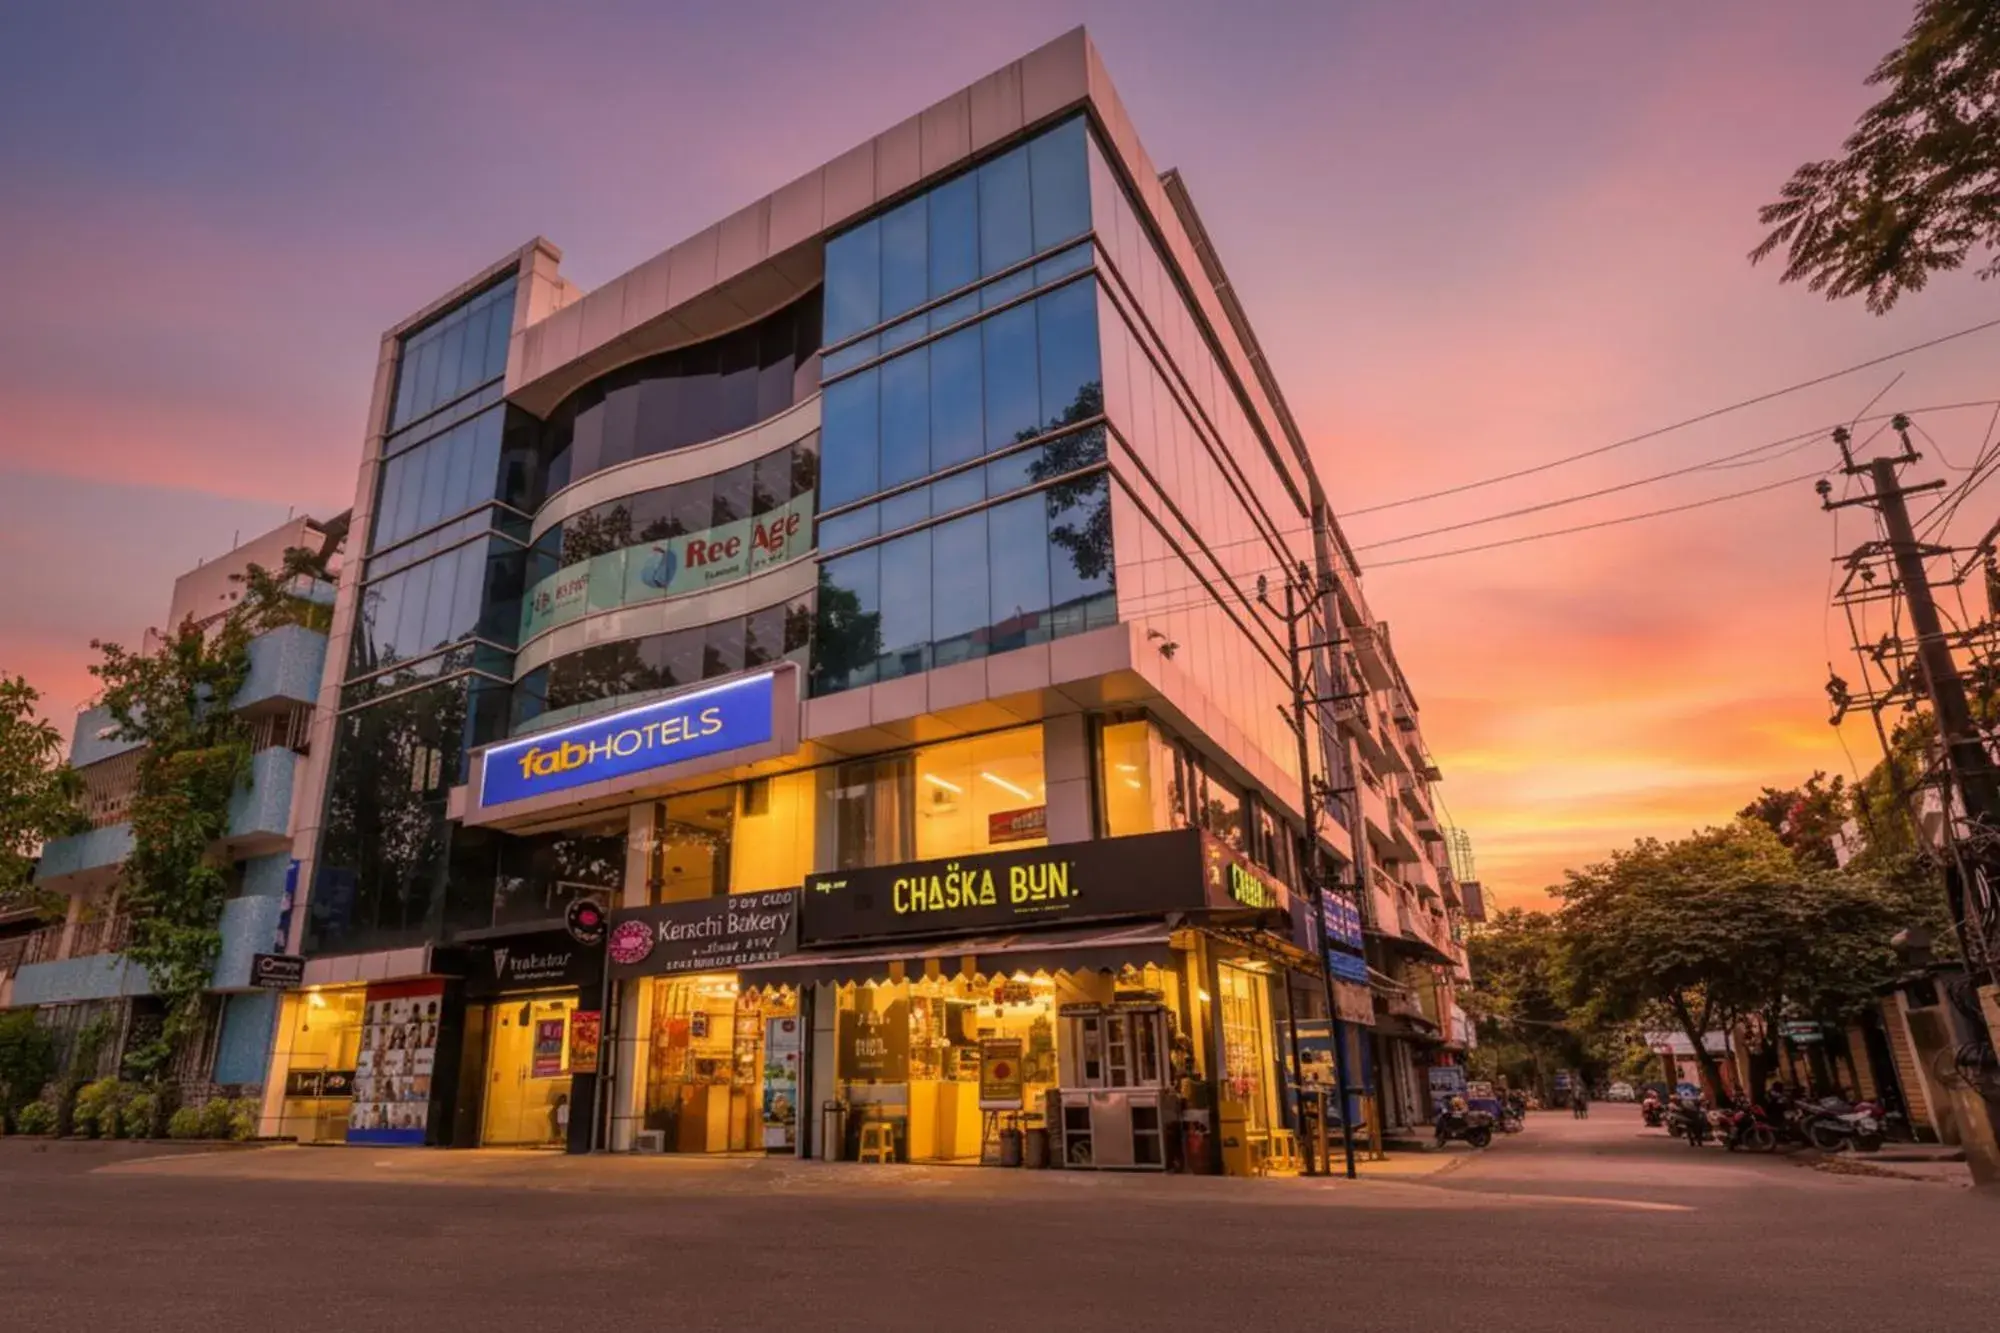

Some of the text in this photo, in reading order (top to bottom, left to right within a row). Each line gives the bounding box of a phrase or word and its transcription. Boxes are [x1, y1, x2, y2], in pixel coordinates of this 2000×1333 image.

[685, 512, 800, 568] Ree Age
[518, 707, 723, 779] fabHOTELS
